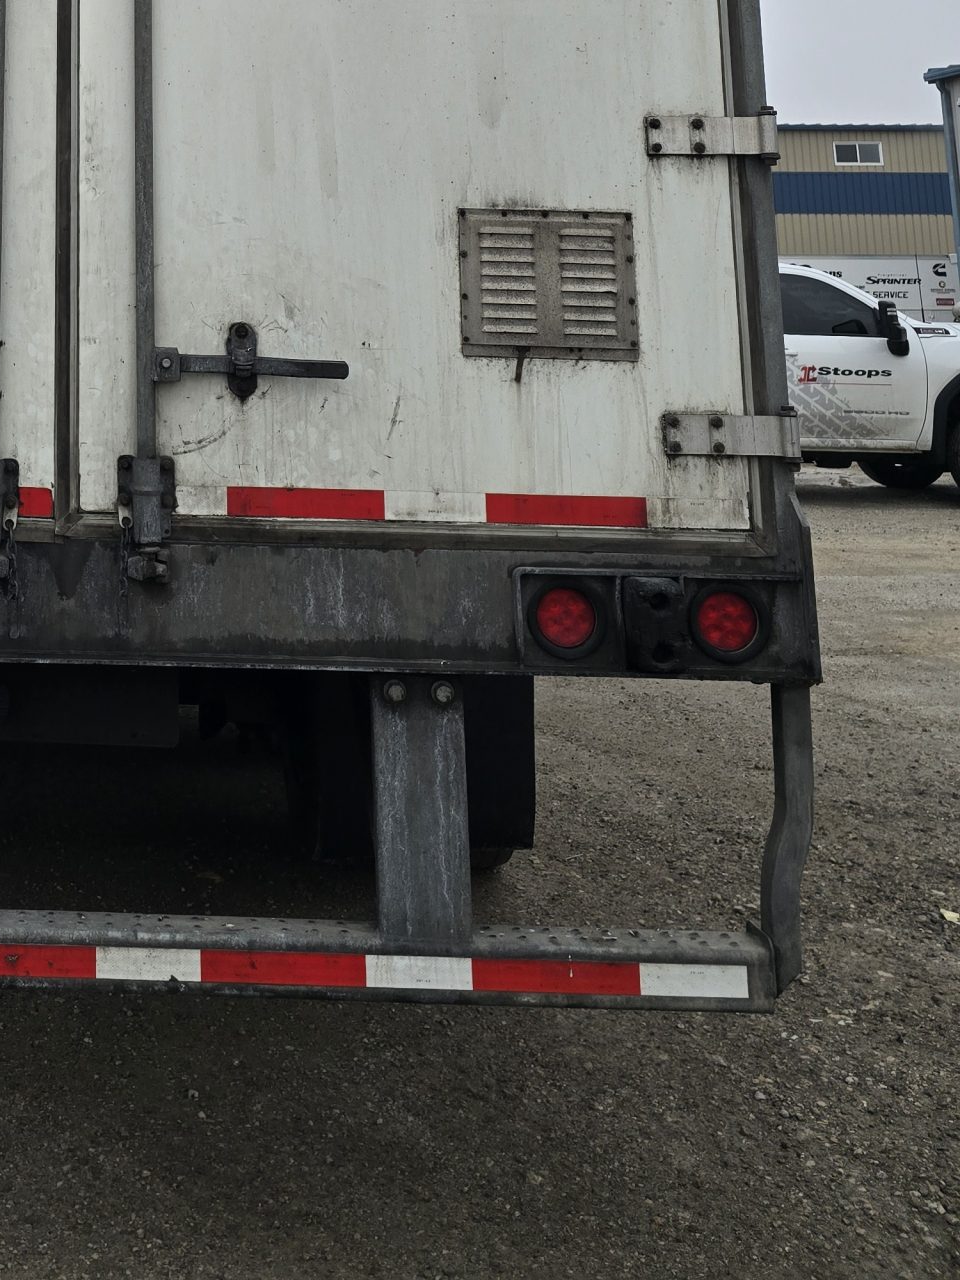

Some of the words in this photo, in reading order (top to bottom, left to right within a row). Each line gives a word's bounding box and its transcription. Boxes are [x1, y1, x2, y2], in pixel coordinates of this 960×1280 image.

[865, 275, 922, 285] SPRINTER
[872, 290, 909, 299] SERVICE
[817, 366, 893, 379] Stoops
